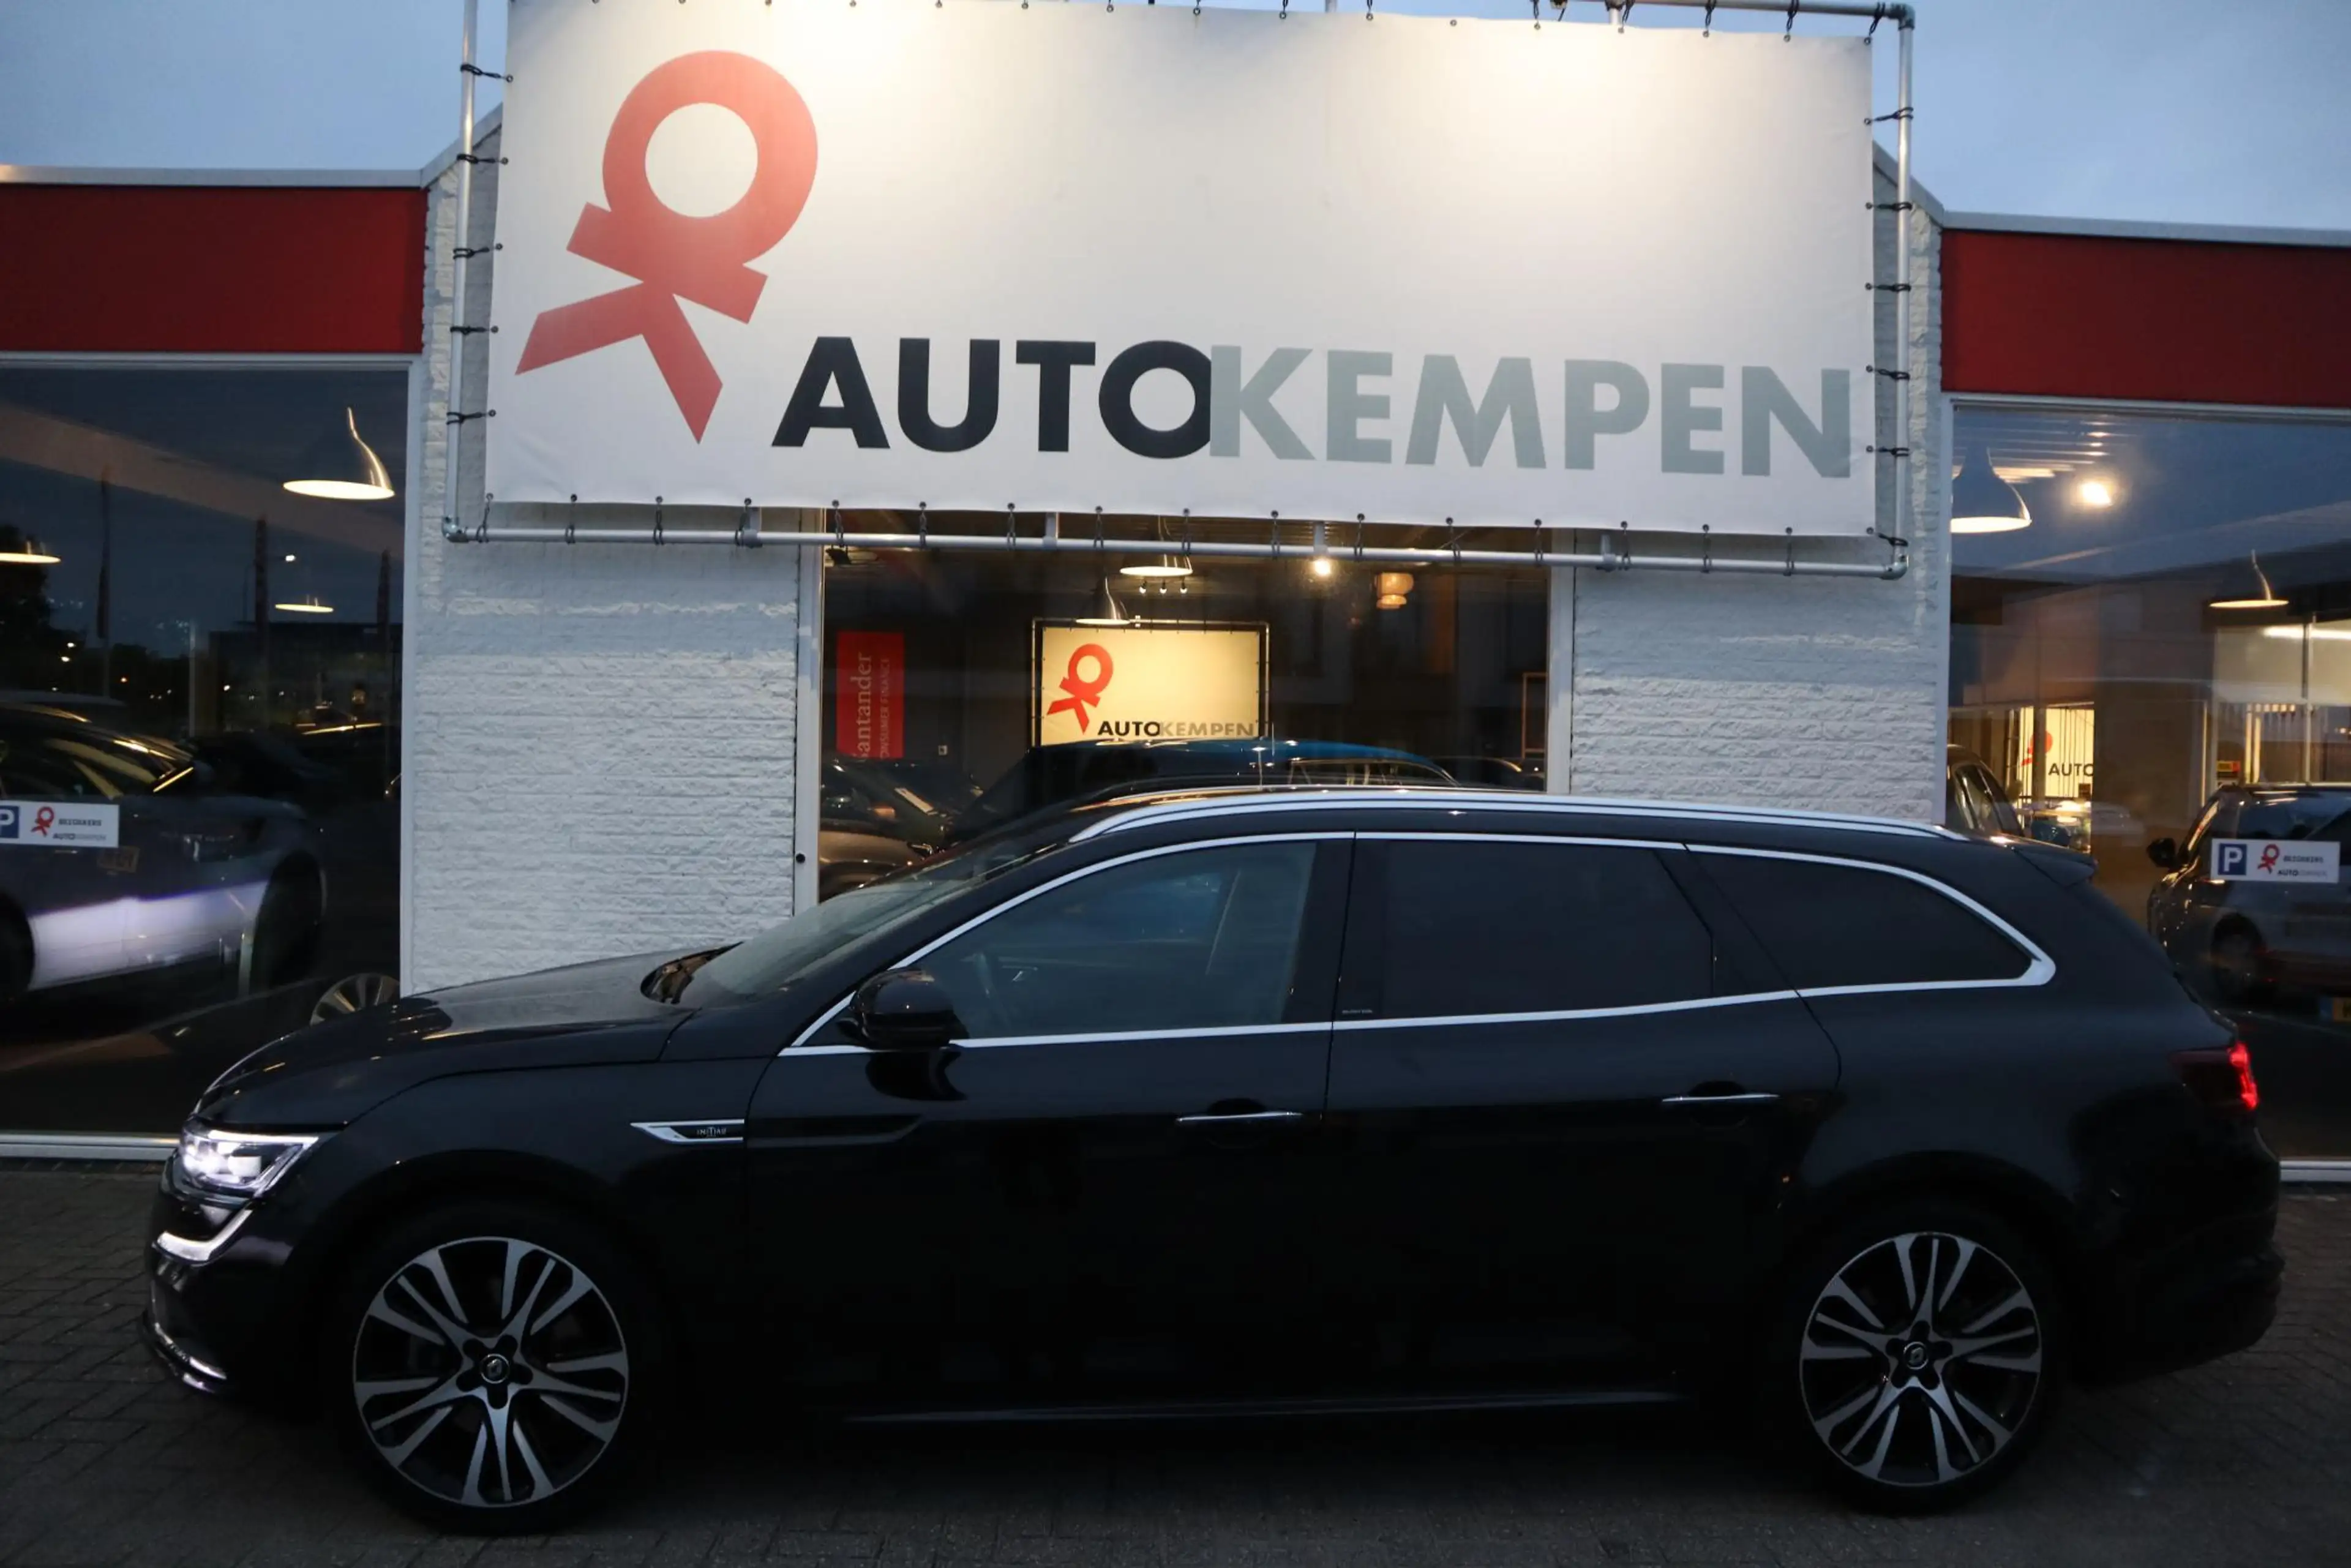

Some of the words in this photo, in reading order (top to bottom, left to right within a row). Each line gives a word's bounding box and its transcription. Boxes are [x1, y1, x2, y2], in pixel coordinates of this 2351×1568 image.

[771, 336, 1851, 478] AUTOKEMPEN
[2048, 763, 2093, 777] AUTO
[2224, 847, 2242, 872] P
